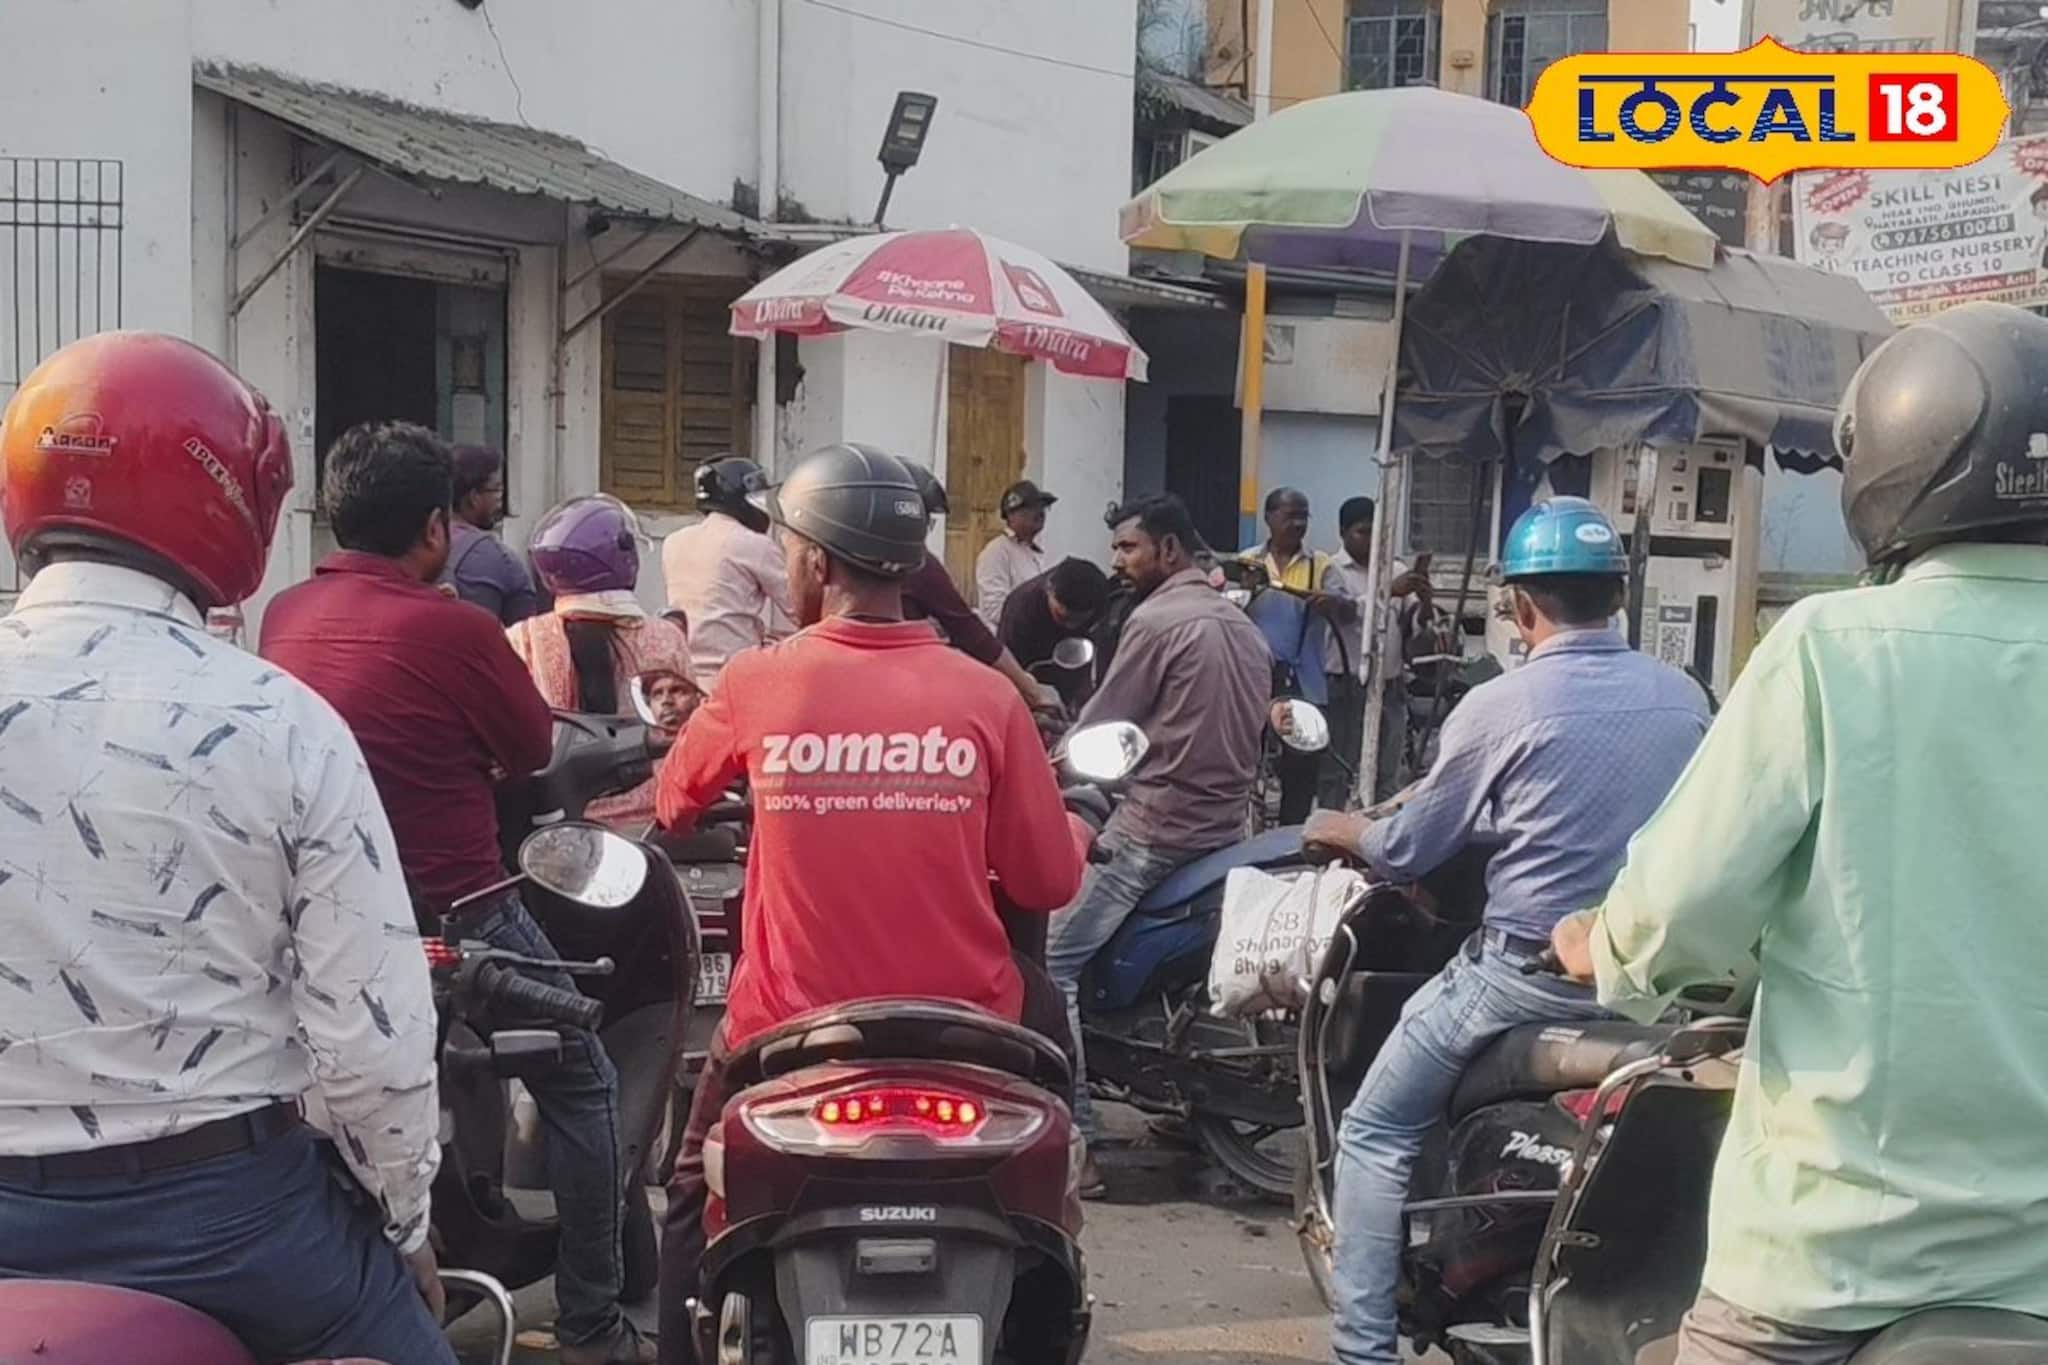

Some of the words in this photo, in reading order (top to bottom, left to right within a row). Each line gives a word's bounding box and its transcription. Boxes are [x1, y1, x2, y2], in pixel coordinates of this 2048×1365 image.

[1872, 185, 1935, 208] SKILL
[1945, 175, 2001, 197] NEST
[1852, 249, 1944, 273] TEACHING
[1952, 235, 2036, 260] NURSERY
[1888, 271, 1910, 285] TO
[1918, 261, 1974, 281] CLASS
[1982, 258, 2003, 271] 10
[762, 725, 977, 777] zomato
[765, 794, 811, 811] 100%
[814, 795, 869, 815] green
[873, 792, 960, 813] deliveries
[860, 1206, 937, 1222] SUZUKI
[839, 1321, 958, 1358] WB72A
